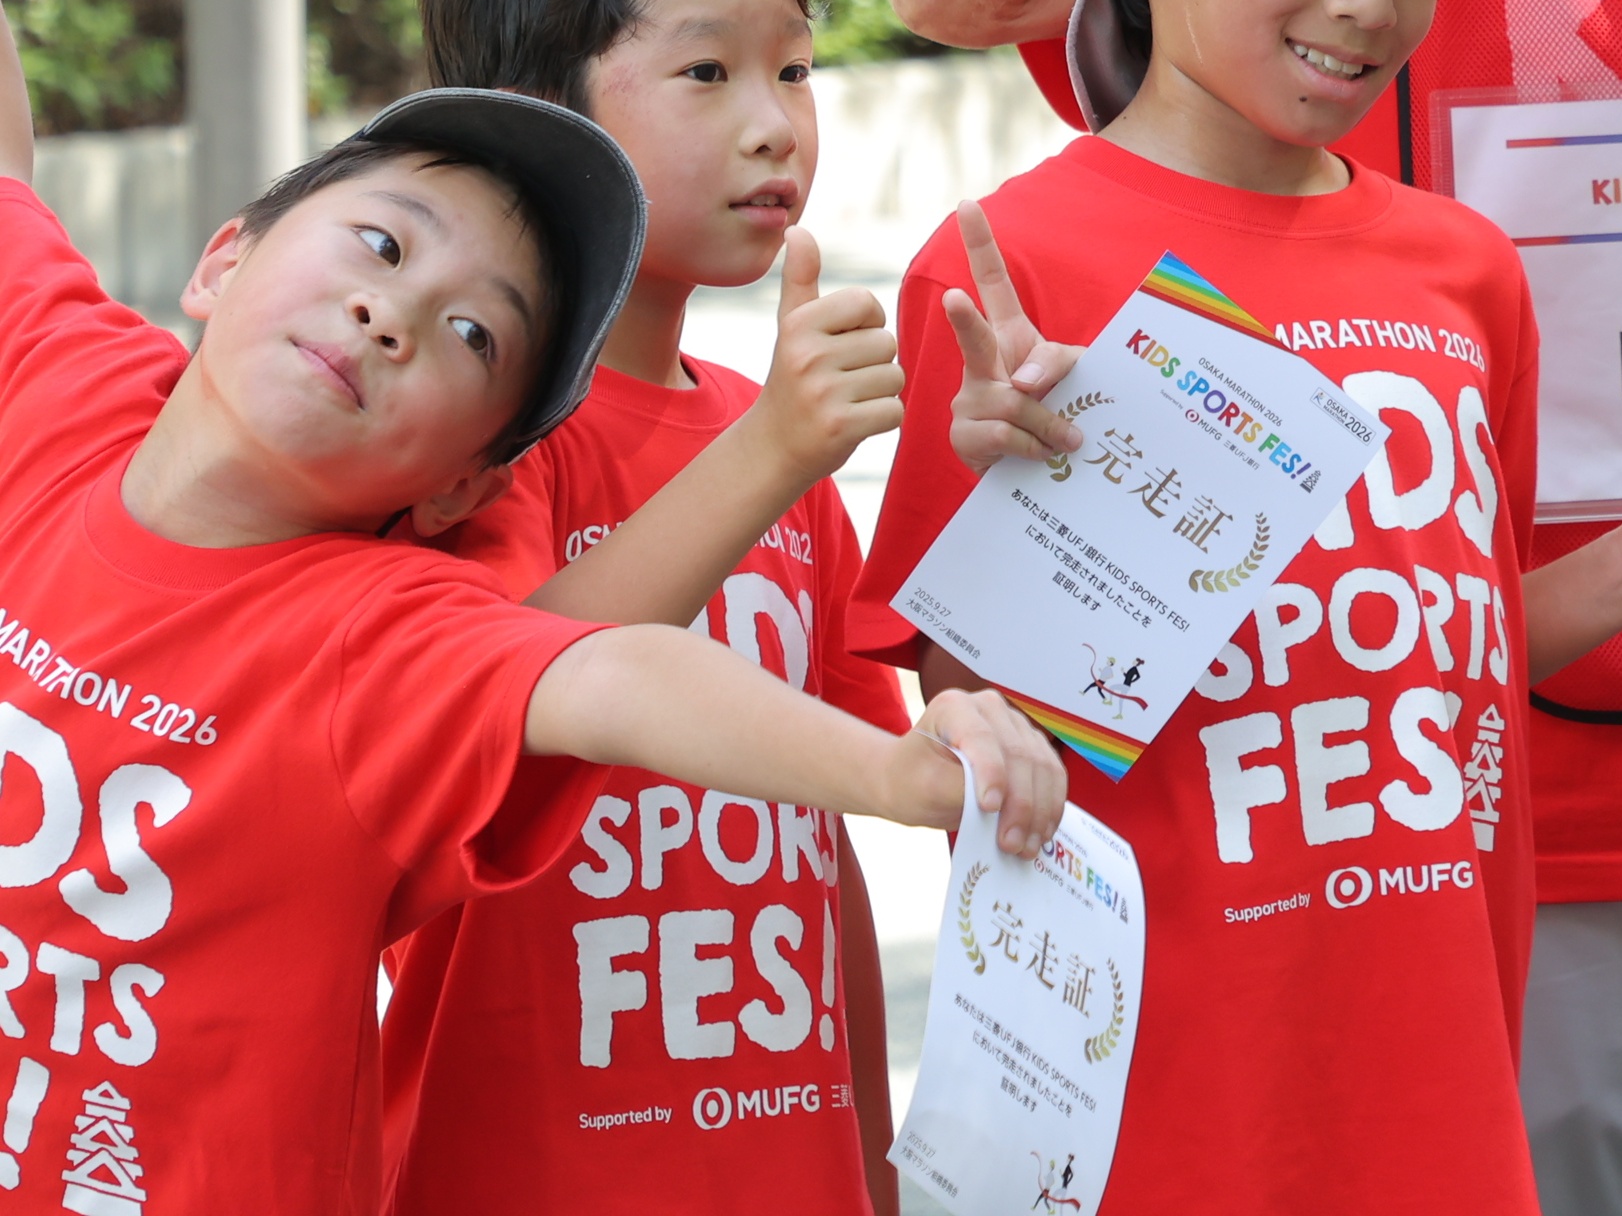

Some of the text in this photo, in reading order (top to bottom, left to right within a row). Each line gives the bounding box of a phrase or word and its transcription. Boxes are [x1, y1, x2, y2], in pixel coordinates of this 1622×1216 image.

[1438, 329, 1486, 373] 2026
[1126, 329, 1312, 480] KIDS SPORTS FES!
[1198, 357, 1283, 427] OSAKA MARATHON 2026
[1326, 398, 1349, 420] OSAKA
[1198, 419, 1223, 442] MUFG
[1344, 416, 1373, 444] 2026
[1082, 427, 1233, 555] 完走証
[785, 525, 814, 565] 202
[1011, 488, 1191, 633] あなたは三菱UFJ銀行 KIDS SPORTS FES!
[1024, 524, 1153, 628] において完走されましたことを
[1052, 570, 1102, 612] 証明します
[913, 586, 952, 618] 2025.9.27
[129, 694, 218, 746] 2026
[1199, 686, 1465, 864] FES
[1086, 866, 1119, 913] FES!
[1224, 860, 1474, 923] Supported by MUFG
[572, 898, 836, 1069] FES!
[988, 901, 1096, 1019] 完走証
[1031, 1052, 1050, 1076] KIDS
[1049, 1067, 1080, 1100] SPORTS
[579, 1108, 652, 1131] Supported
[654, 1106, 672, 1124] by
[737, 1084, 820, 1120] MUFG
